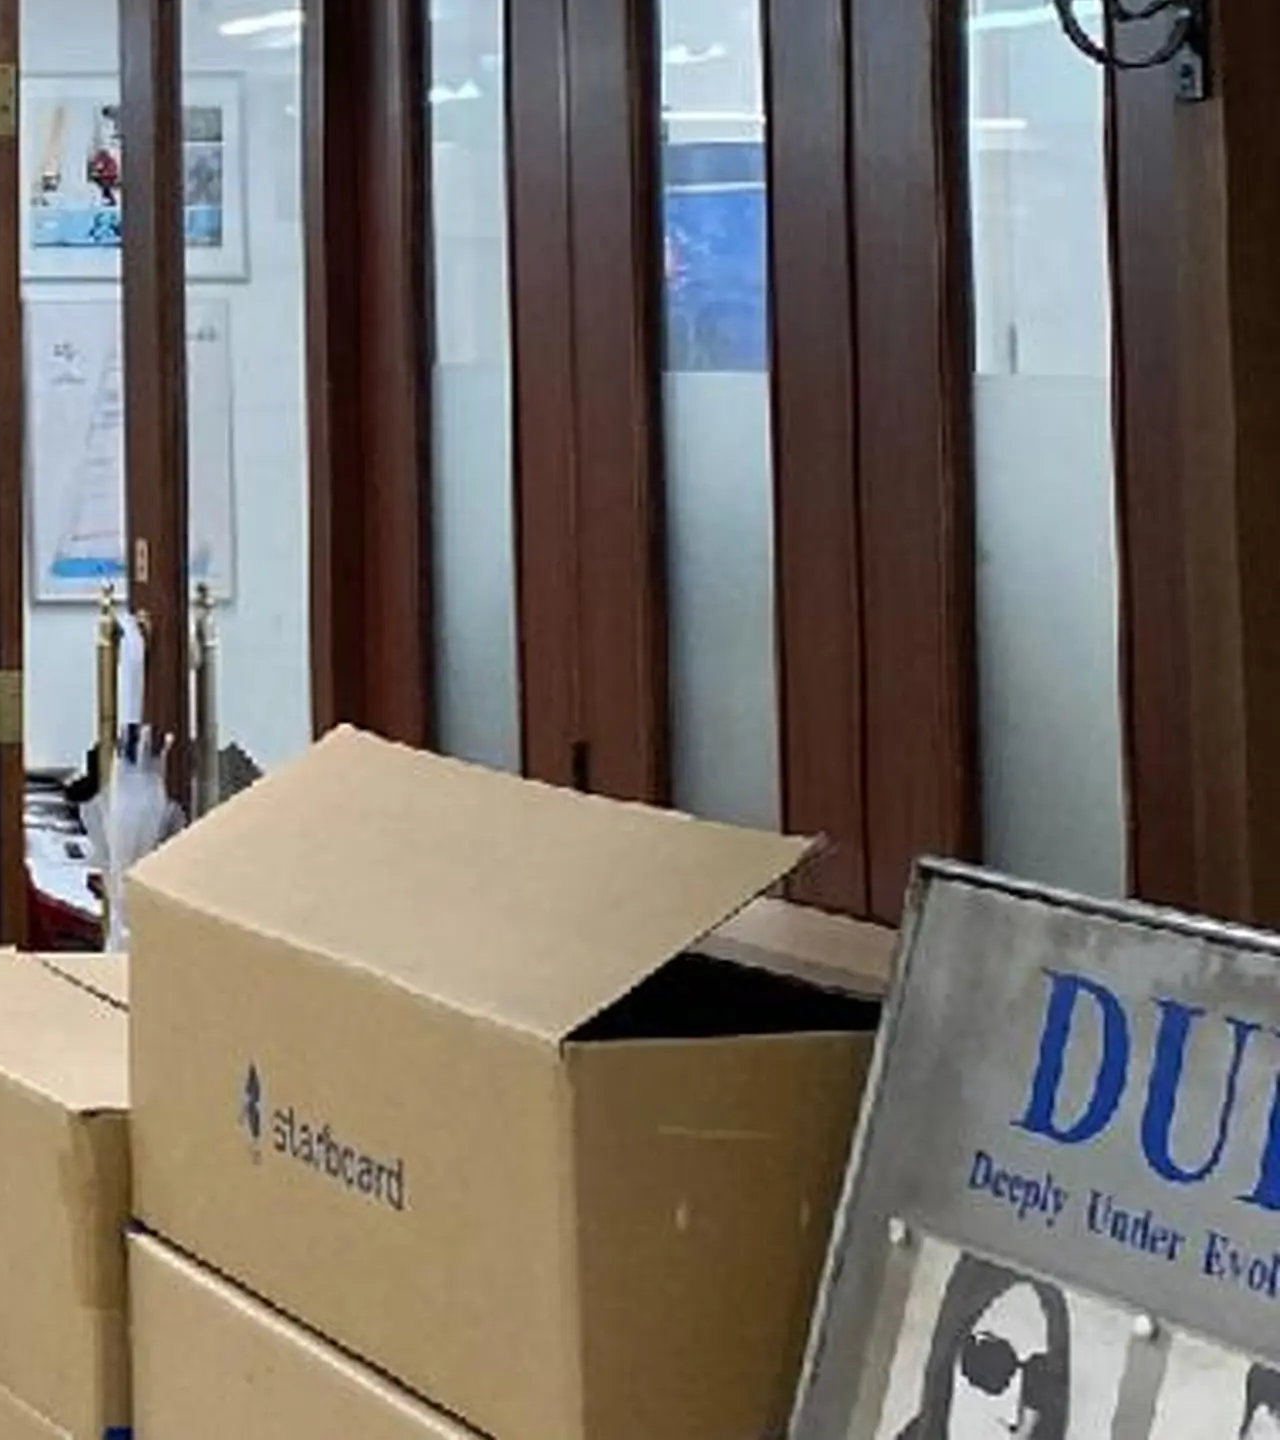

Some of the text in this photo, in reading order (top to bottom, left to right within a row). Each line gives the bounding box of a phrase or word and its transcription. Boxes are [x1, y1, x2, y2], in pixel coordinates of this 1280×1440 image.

[1010, 967, 1280, 1211] DU
[272, 1104, 405, 1212] starboard
[968, 1148, 1068, 1228] Deeply
[1087, 1188, 1186, 1261] Under
